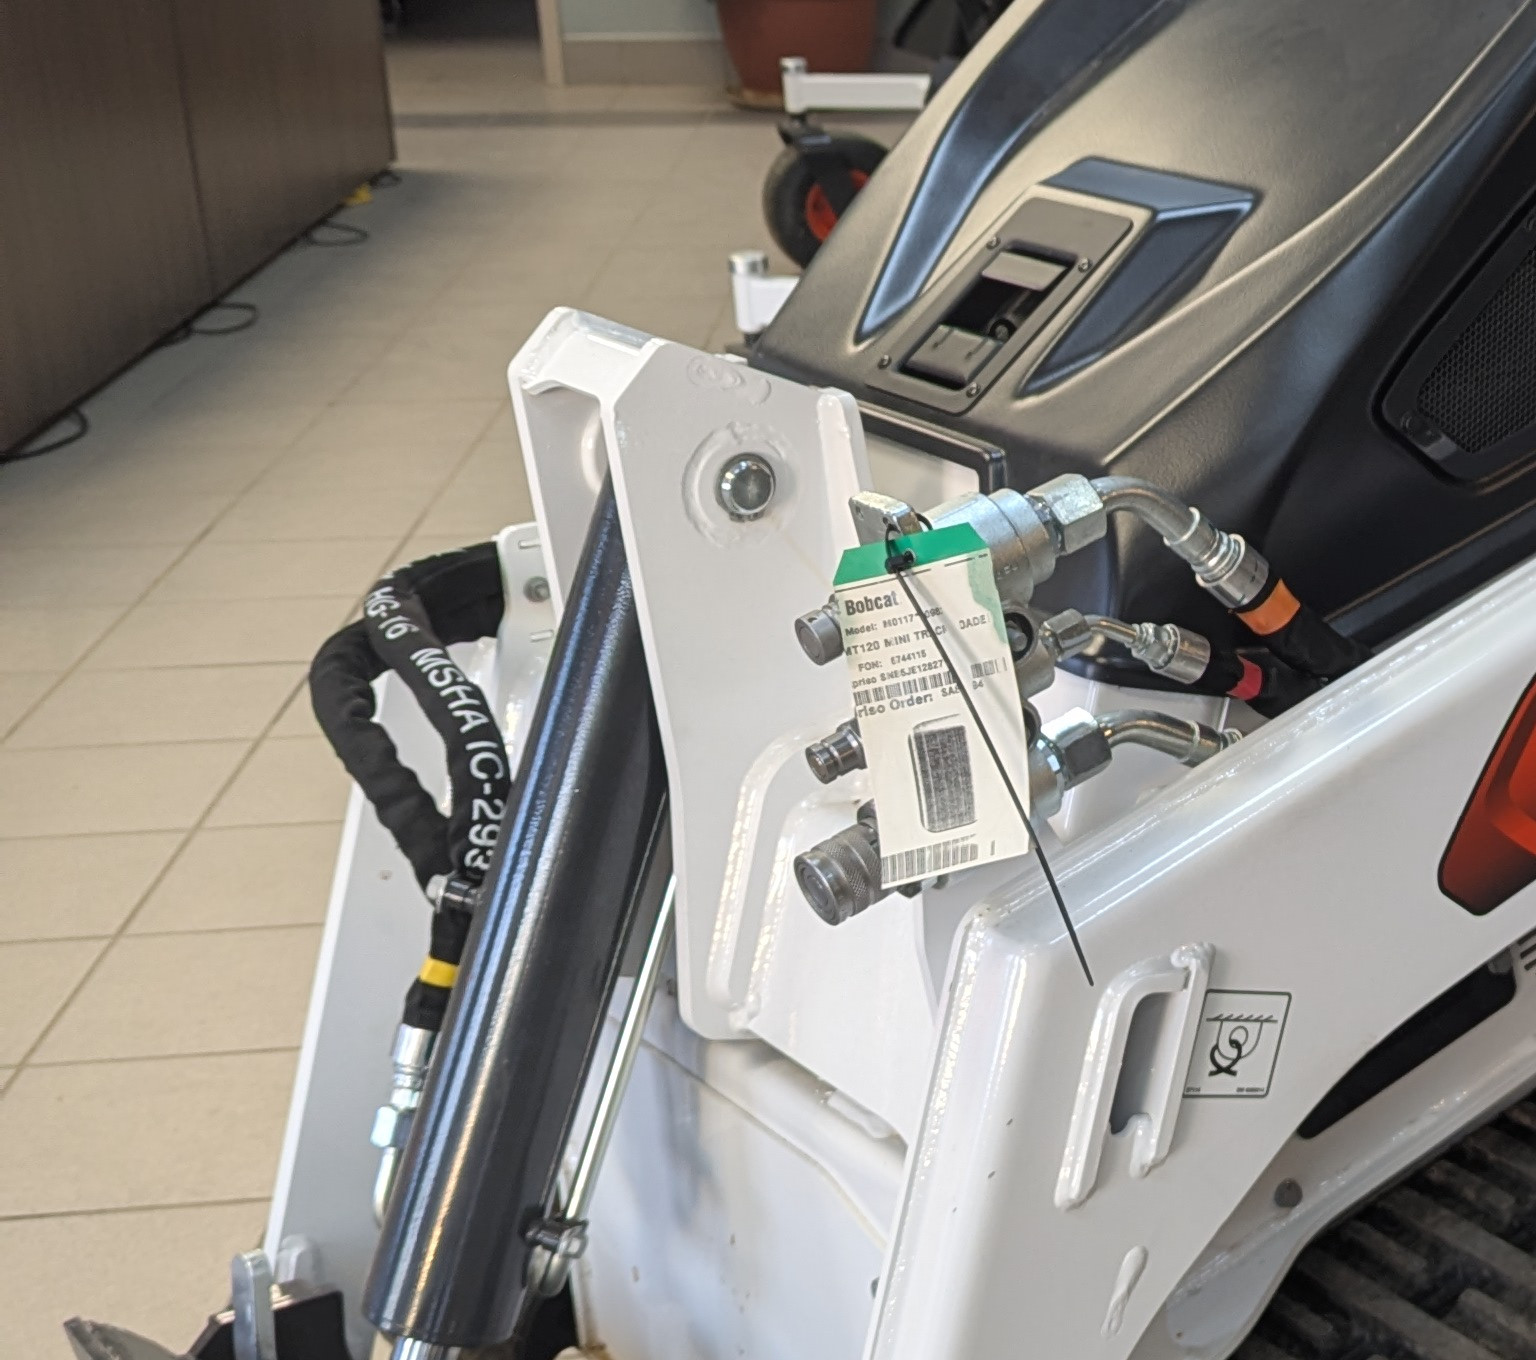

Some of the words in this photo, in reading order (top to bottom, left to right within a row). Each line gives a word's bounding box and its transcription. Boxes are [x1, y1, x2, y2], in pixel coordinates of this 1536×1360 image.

[845, 590, 900, 616] Bobcat
[845, 623, 878, 637] Model:
[410, 647, 490, 734] MSHA
[889, 693, 934, 711] Order:
